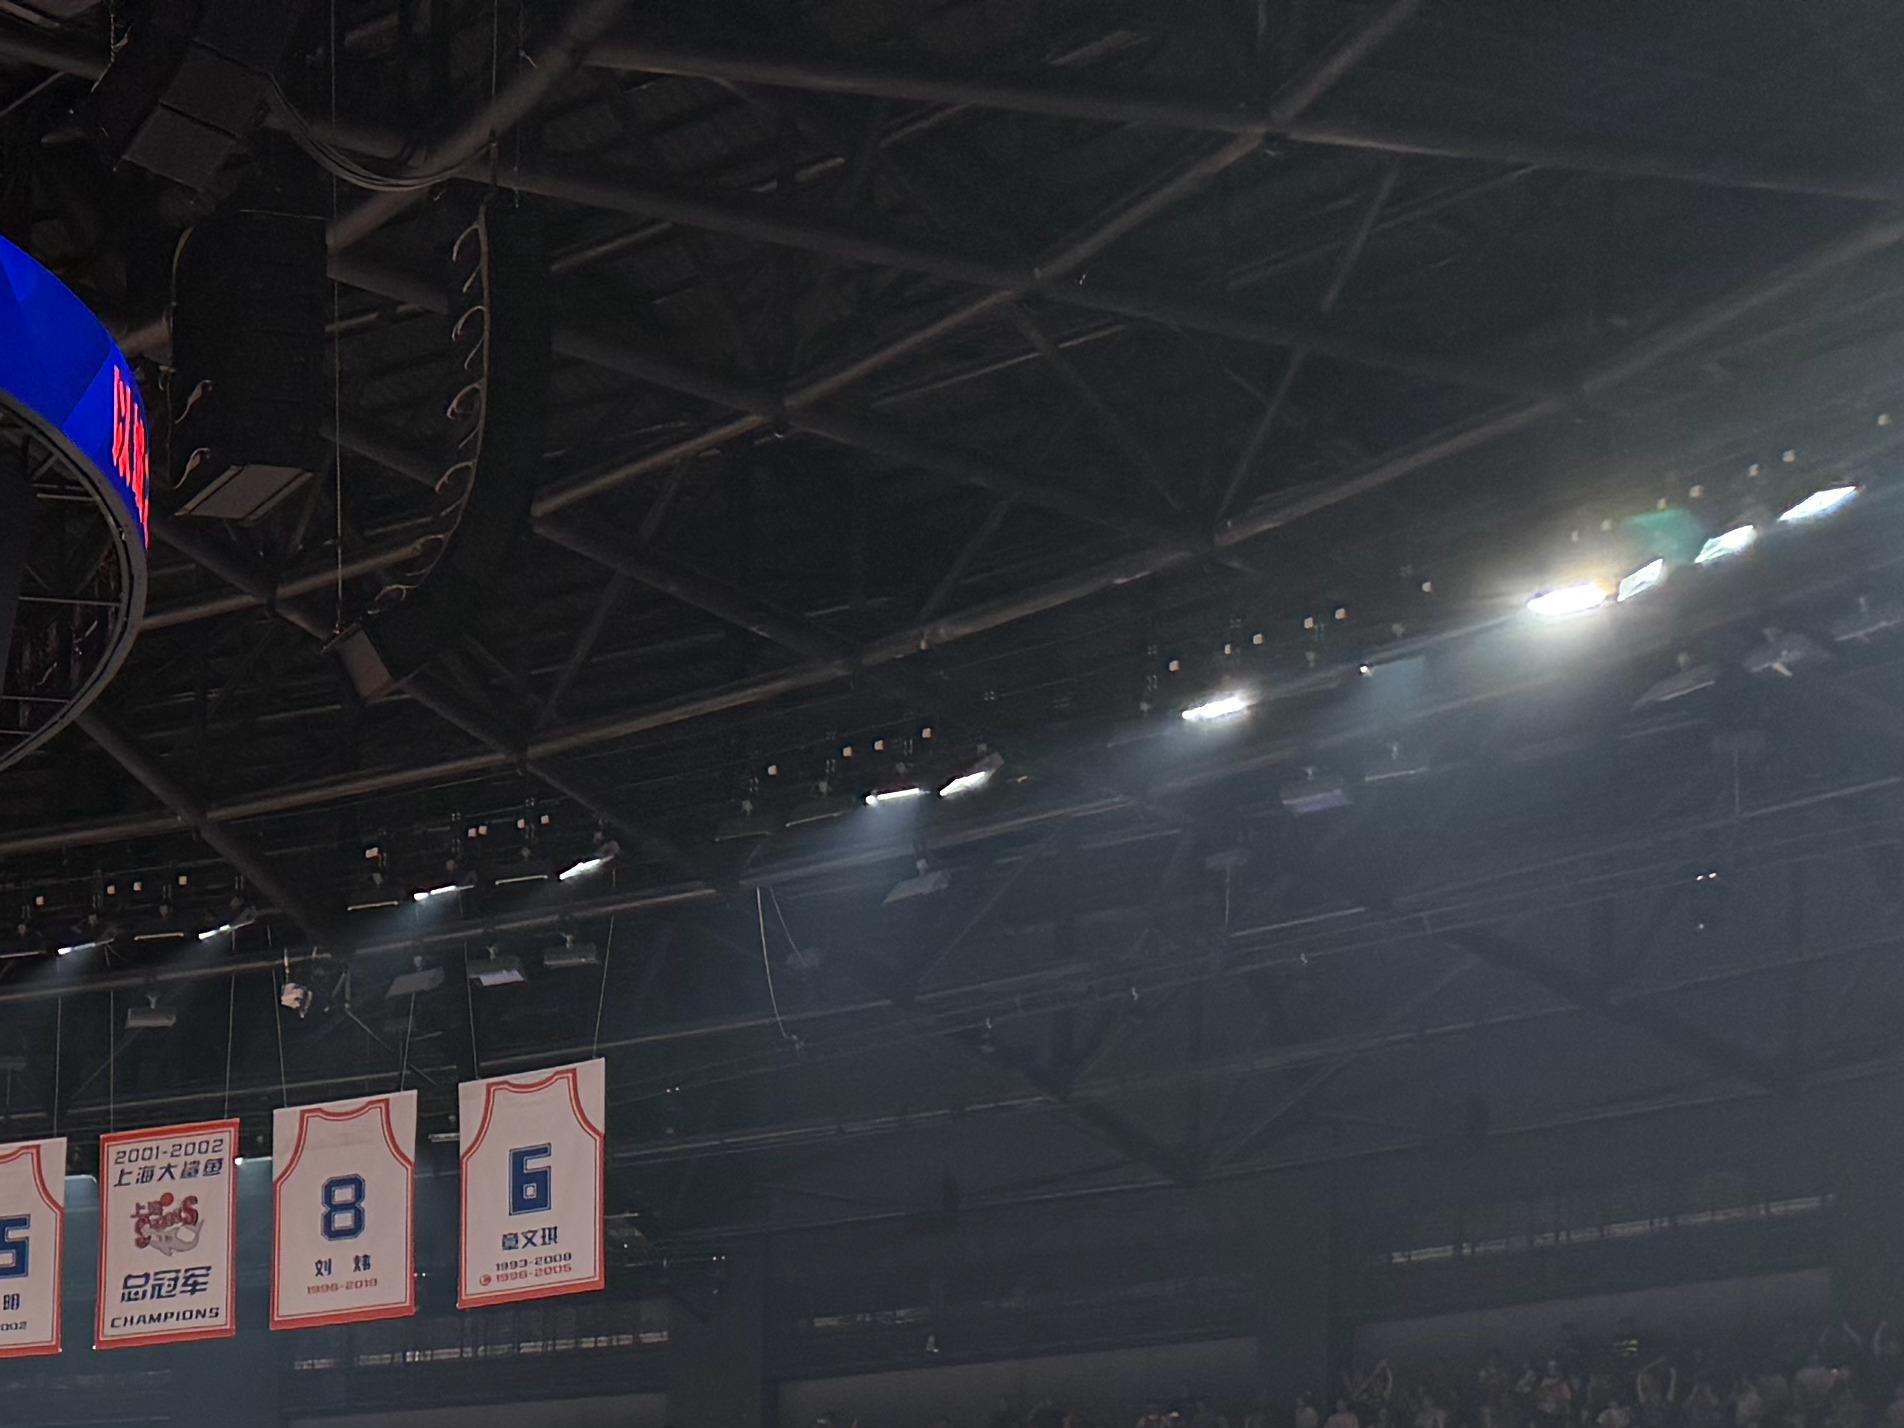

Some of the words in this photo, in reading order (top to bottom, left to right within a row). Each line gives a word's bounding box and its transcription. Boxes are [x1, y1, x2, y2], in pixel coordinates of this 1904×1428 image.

[114, 1137, 225, 1166] 2001-2002
[113, 1158, 224, 1188] 上海大鲨鱼
[508, 1142, 552, 1216] 6
[321, 1173, 366, 1242] 8
[120, 1265, 212, 1304] 总冠军
[110, 1306, 220, 1330] CHAMPIONS
